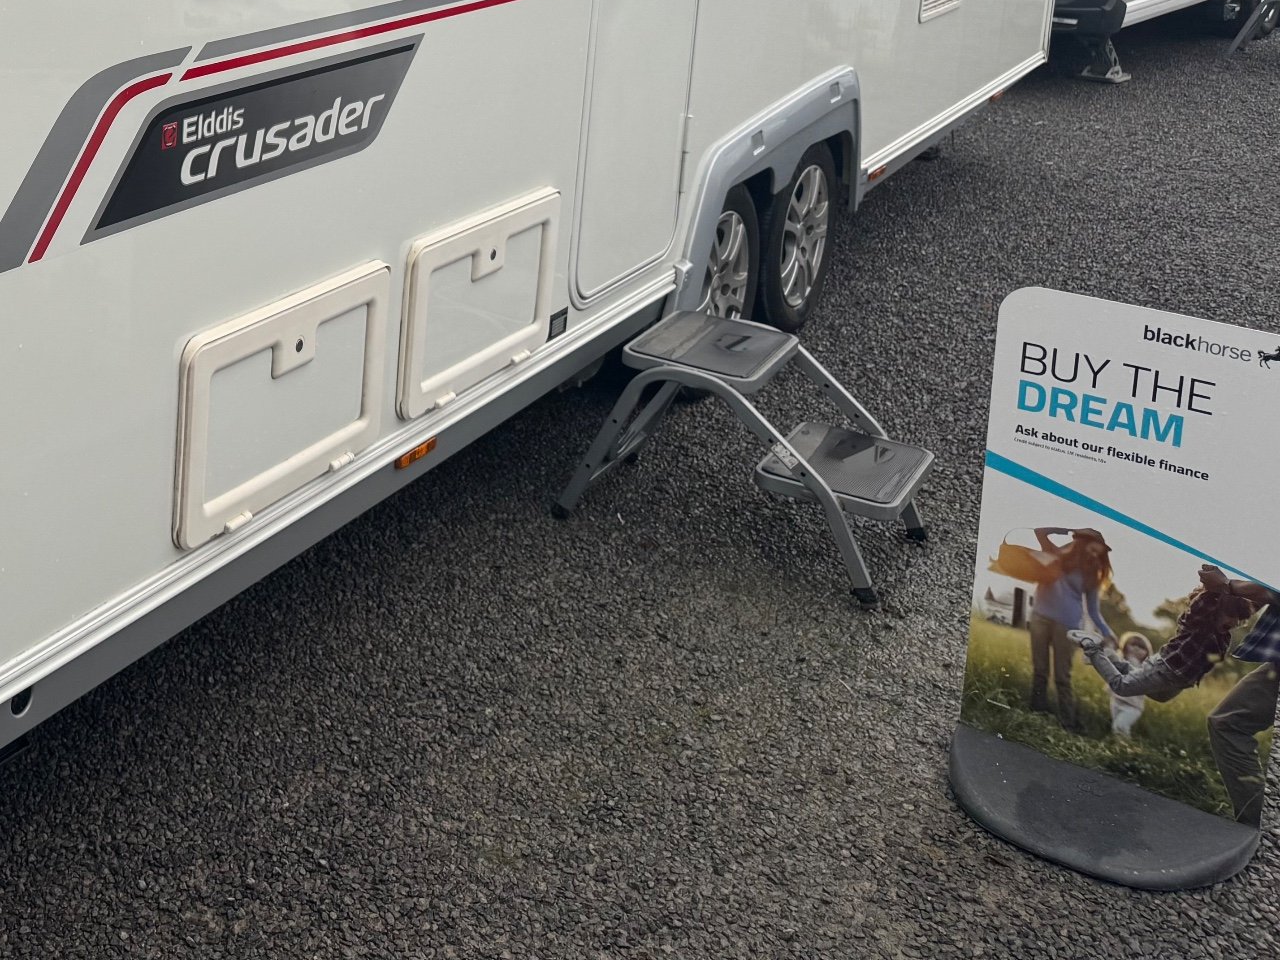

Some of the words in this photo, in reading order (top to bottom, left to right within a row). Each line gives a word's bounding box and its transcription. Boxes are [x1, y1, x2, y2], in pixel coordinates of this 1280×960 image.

[180, 93, 385, 186] crusader
[182, 106, 245, 145] Elddis
[1143, 324, 1252, 362] blackhorse
[1020, 341, 1111, 389] BUY
[1122, 362, 1217, 416] THE
[1017, 379, 1184, 449] DREAM
[1015, 424, 1039, 439] Ask
[1041, 431, 1079, 449] about
[1081, 440, 1104, 455] our
[1106, 445, 1156, 468] flexible
[1158, 459, 1210, 482] finance
